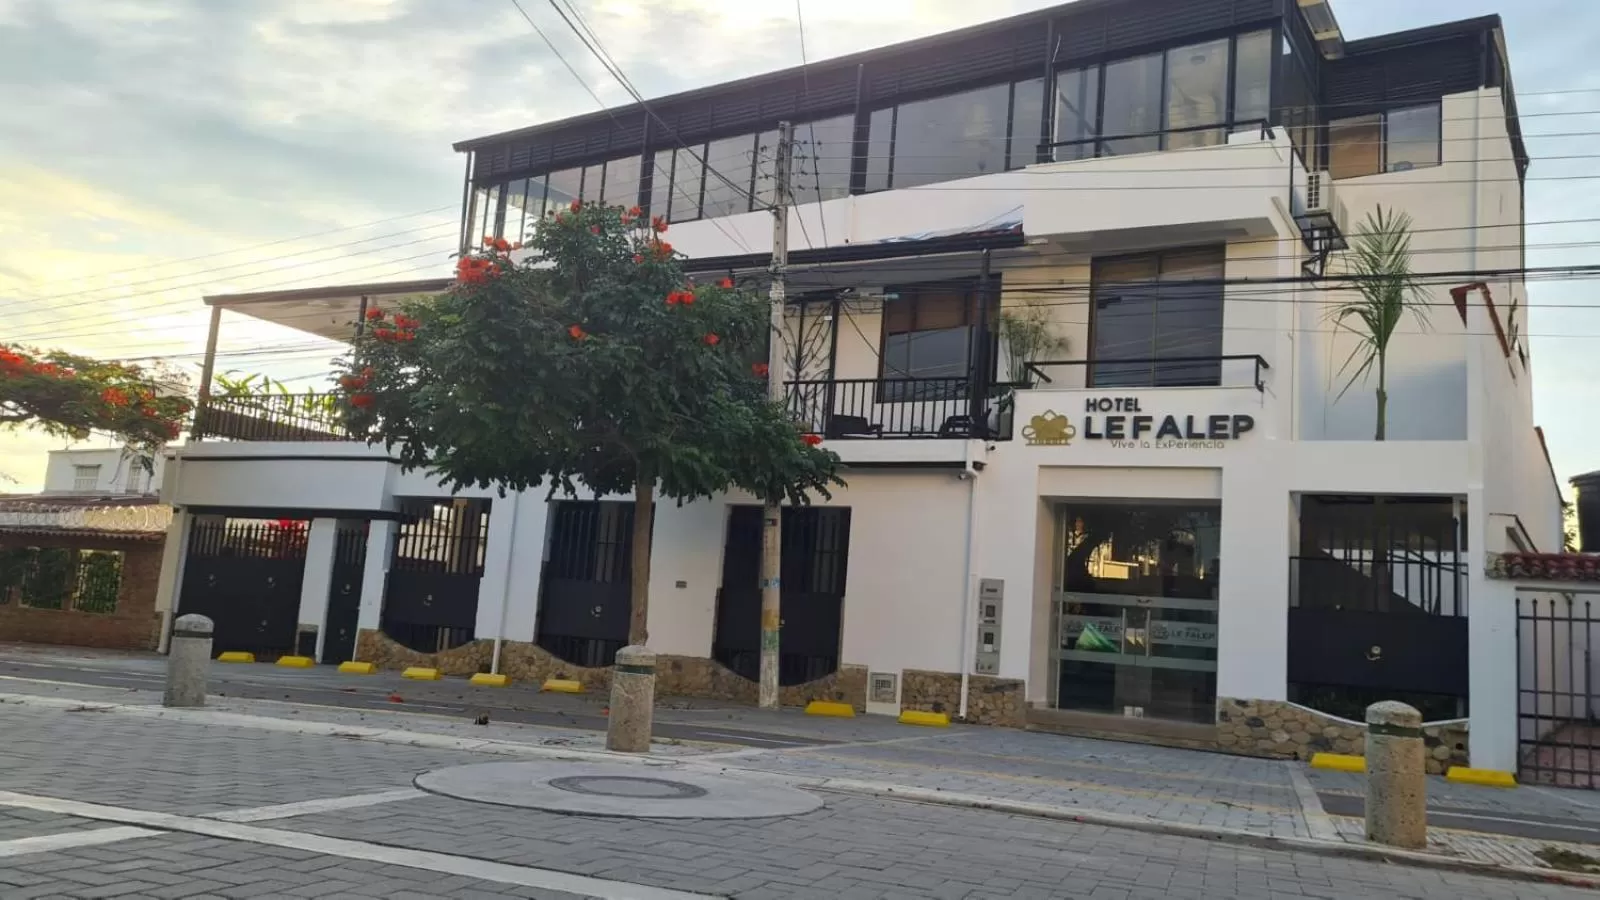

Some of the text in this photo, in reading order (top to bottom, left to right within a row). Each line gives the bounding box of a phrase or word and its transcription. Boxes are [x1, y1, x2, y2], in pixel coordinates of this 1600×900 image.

[1085, 397, 1142, 412] HOTEL
[1111, 439, 1136, 449] Vive
[1140, 439, 1150, 449] la
